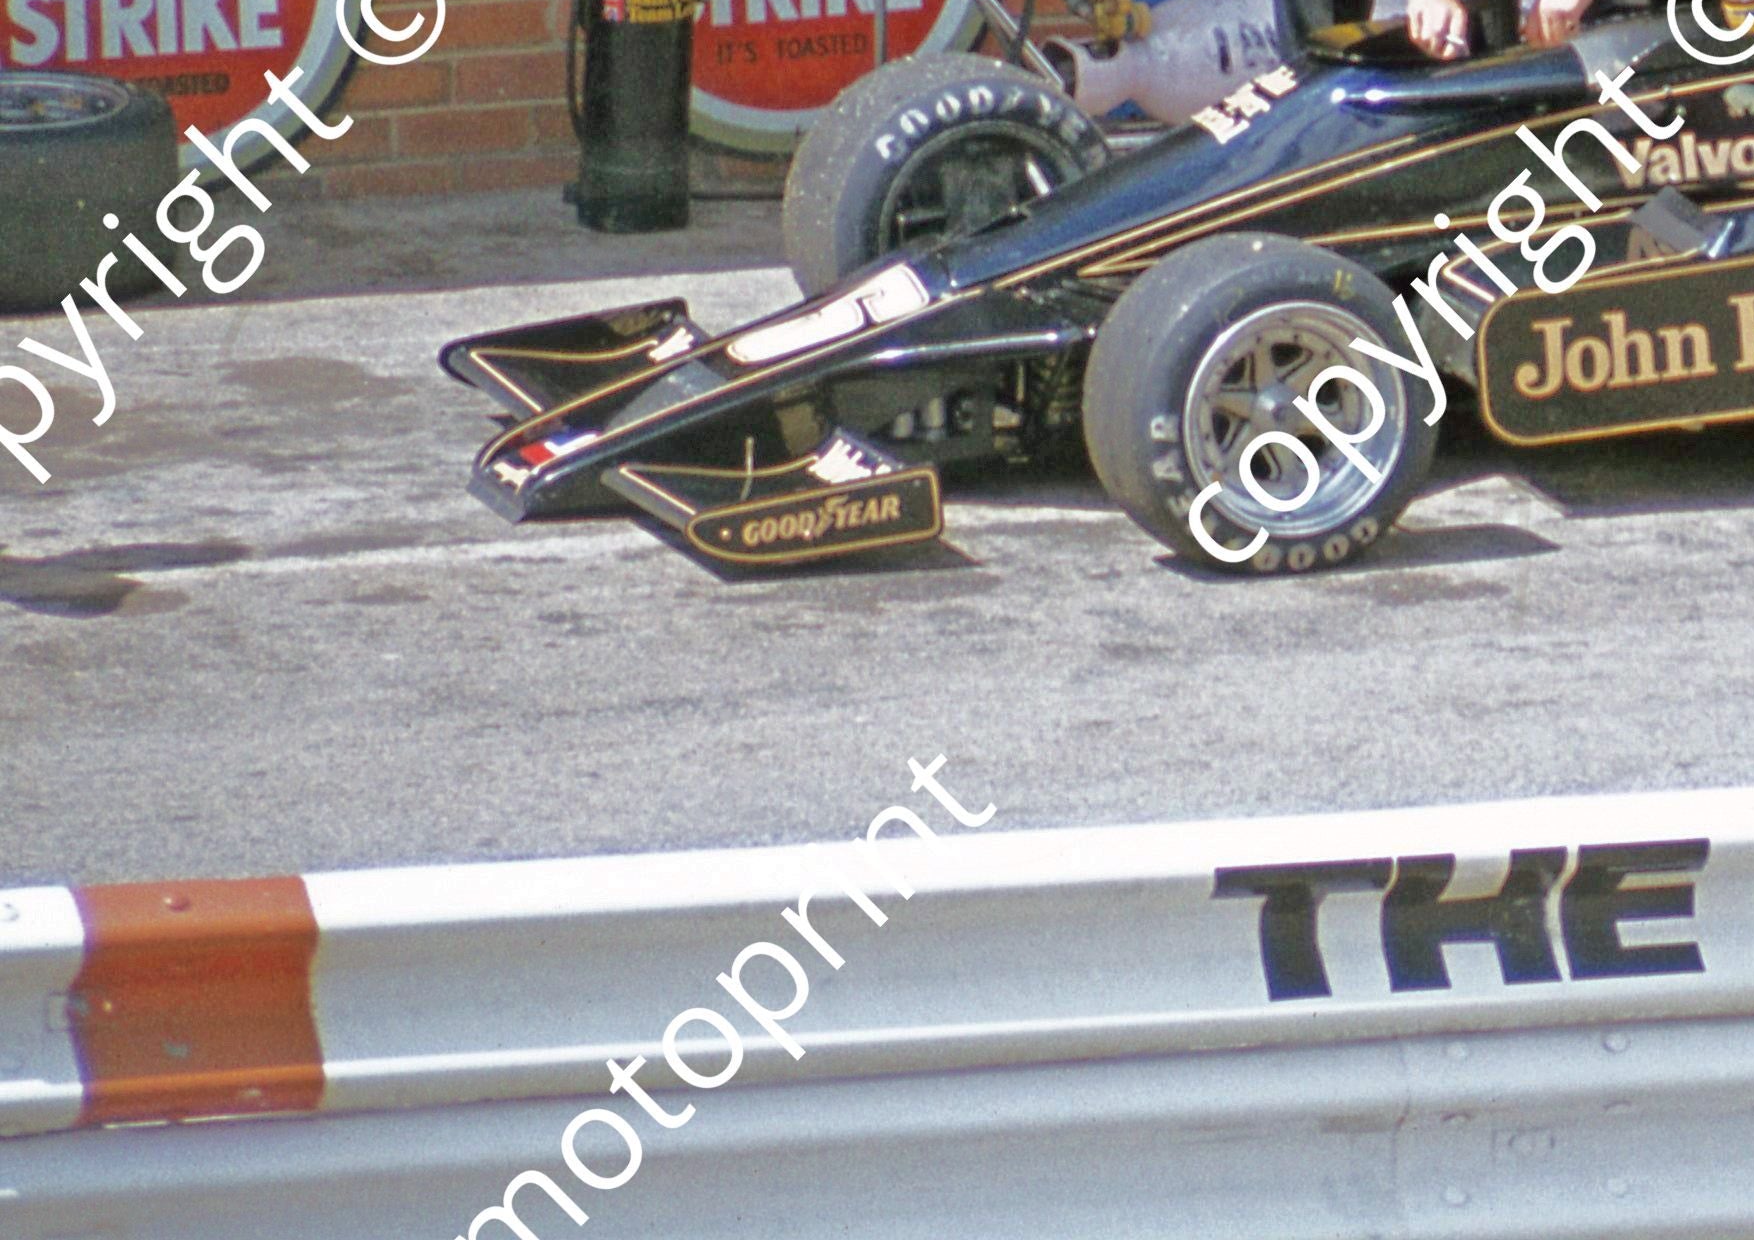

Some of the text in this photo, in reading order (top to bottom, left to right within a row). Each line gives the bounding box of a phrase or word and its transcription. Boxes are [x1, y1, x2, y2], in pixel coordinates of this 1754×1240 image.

[776, 32, 869, 59] TOASTED
[1514, 309, 1713, 400] John
[741, 493, 900, 548] GOODYEAR
[1210, 838, 1711, 1002] THE
